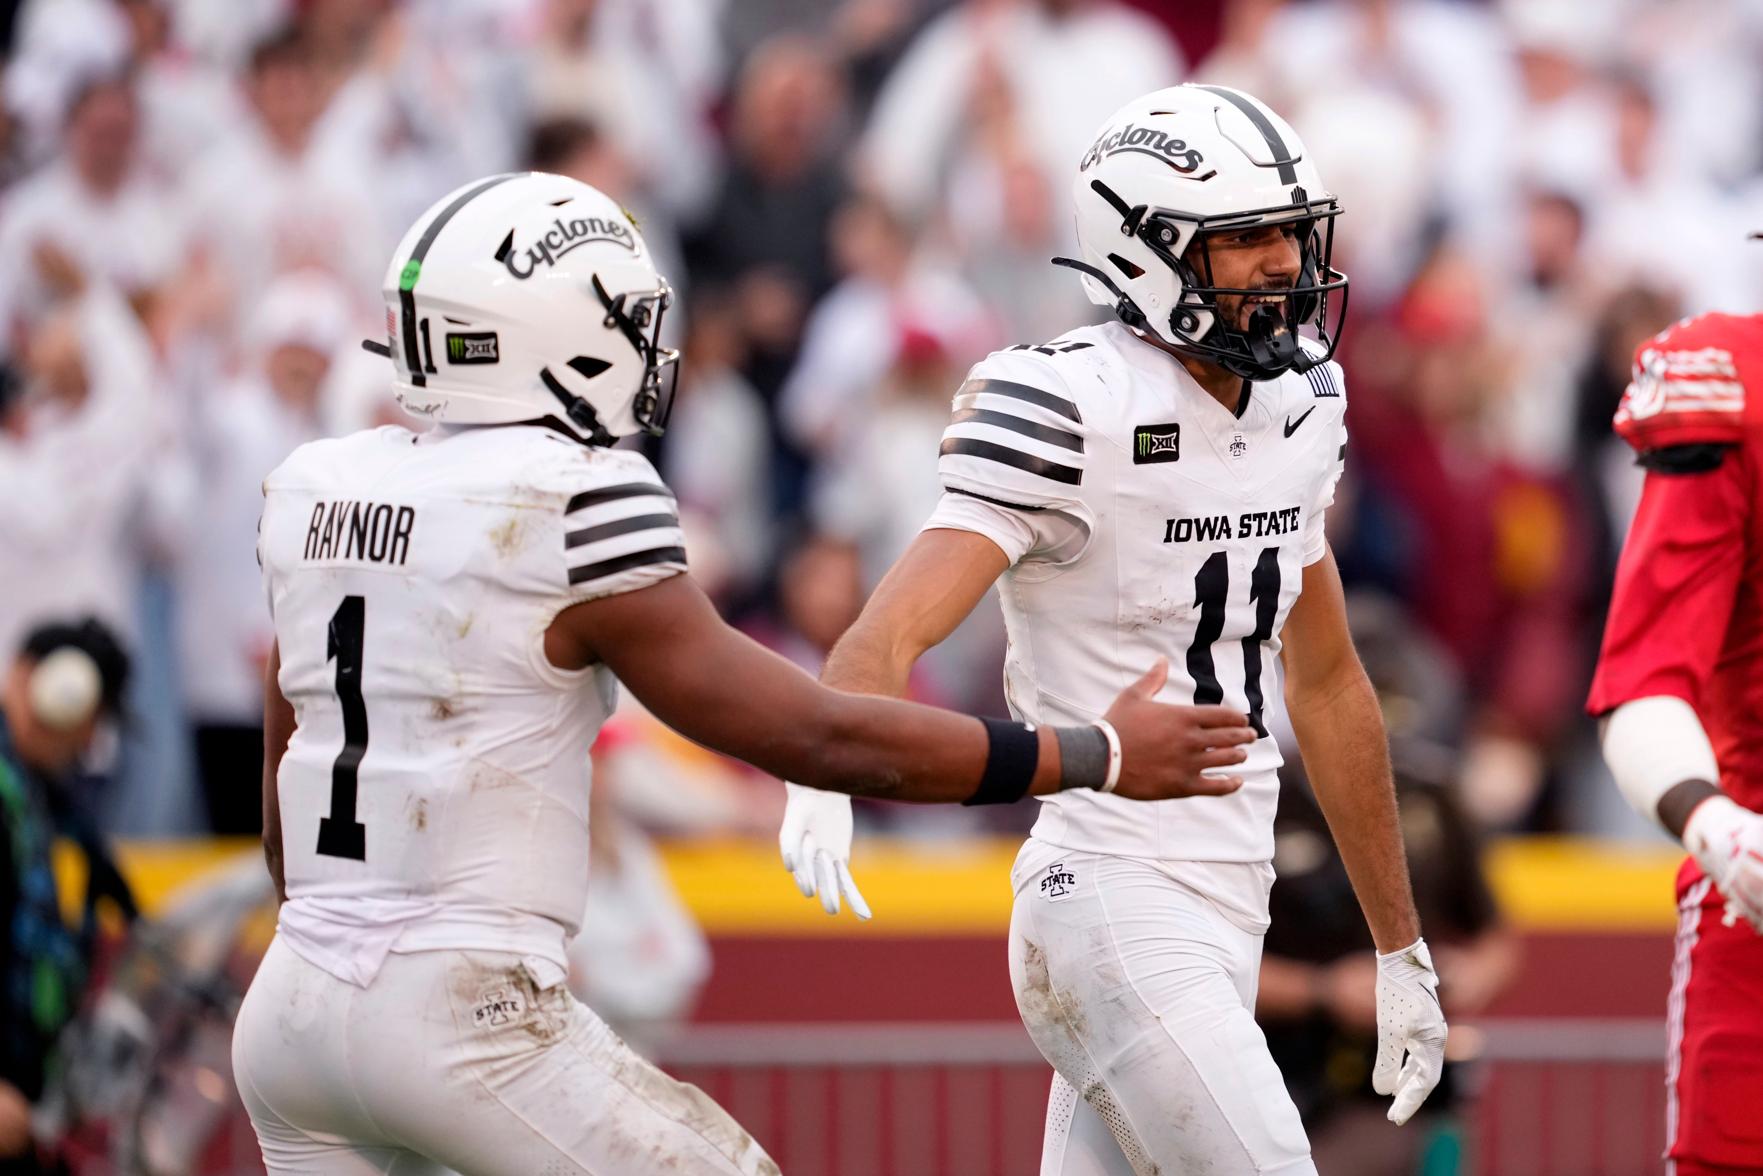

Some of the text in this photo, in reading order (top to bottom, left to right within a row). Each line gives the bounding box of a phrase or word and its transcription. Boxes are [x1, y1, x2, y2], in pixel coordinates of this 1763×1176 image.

[1080, 123, 1204, 173] Cyclones
[420, 317, 438, 375] 1
[303, 501, 416, 567] RAYNOR
[1163, 506, 1301, 543] IOWA STATE
[1186, 546, 1282, 740] 11
[316, 595, 369, 862] 1
[1041, 873, 1075, 892] STATE
[476, 1001, 520, 1021] STATE
